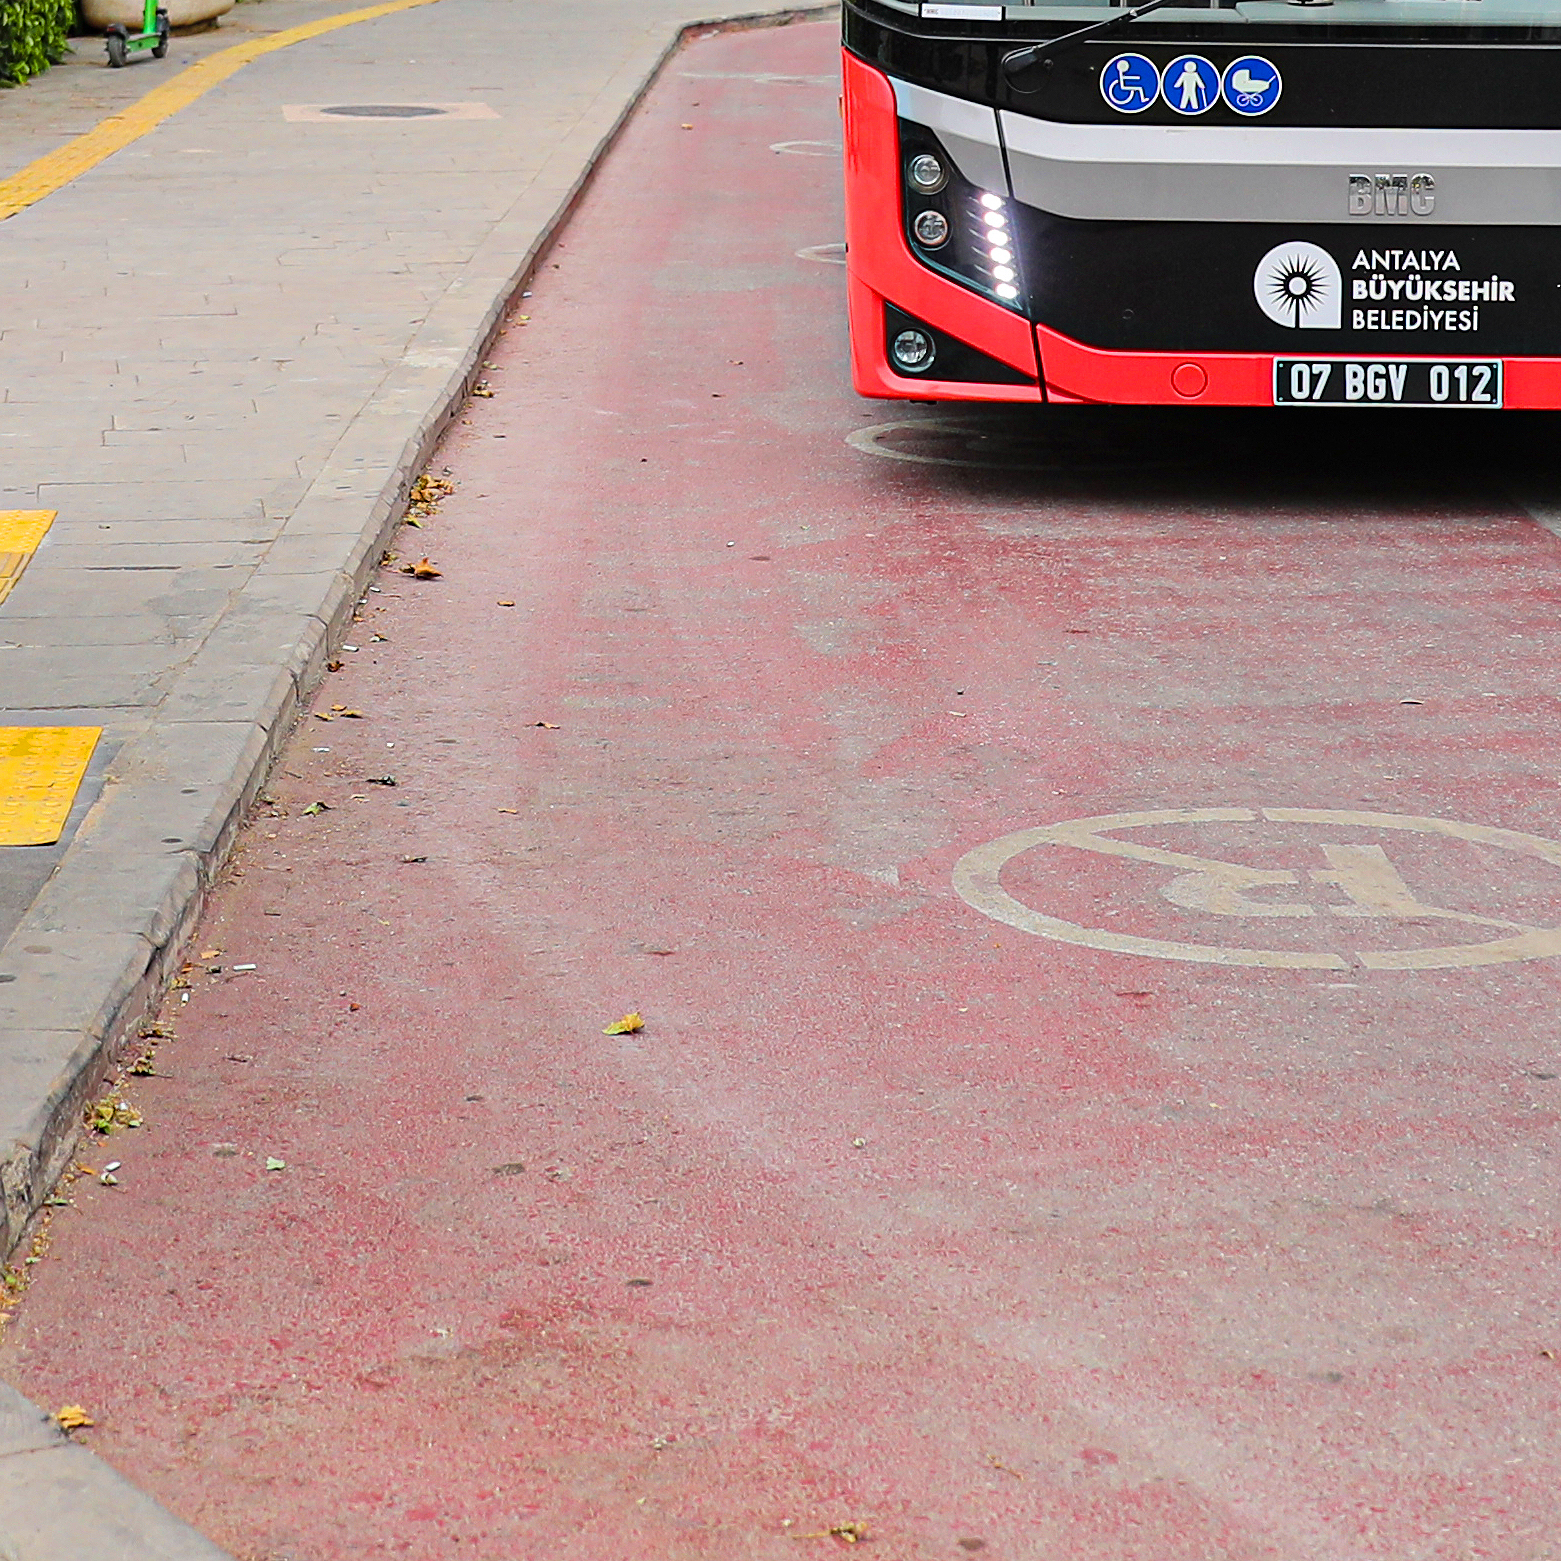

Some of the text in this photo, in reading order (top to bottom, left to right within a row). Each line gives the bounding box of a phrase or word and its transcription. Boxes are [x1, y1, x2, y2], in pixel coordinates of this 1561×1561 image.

[1348, 172, 1436, 216] BMC
[1352, 249, 1461, 271] ANTALYA
[1352, 305, 1479, 331] BELEDİYESİ
[1290, 363, 1493, 402] 07 BGV 012
